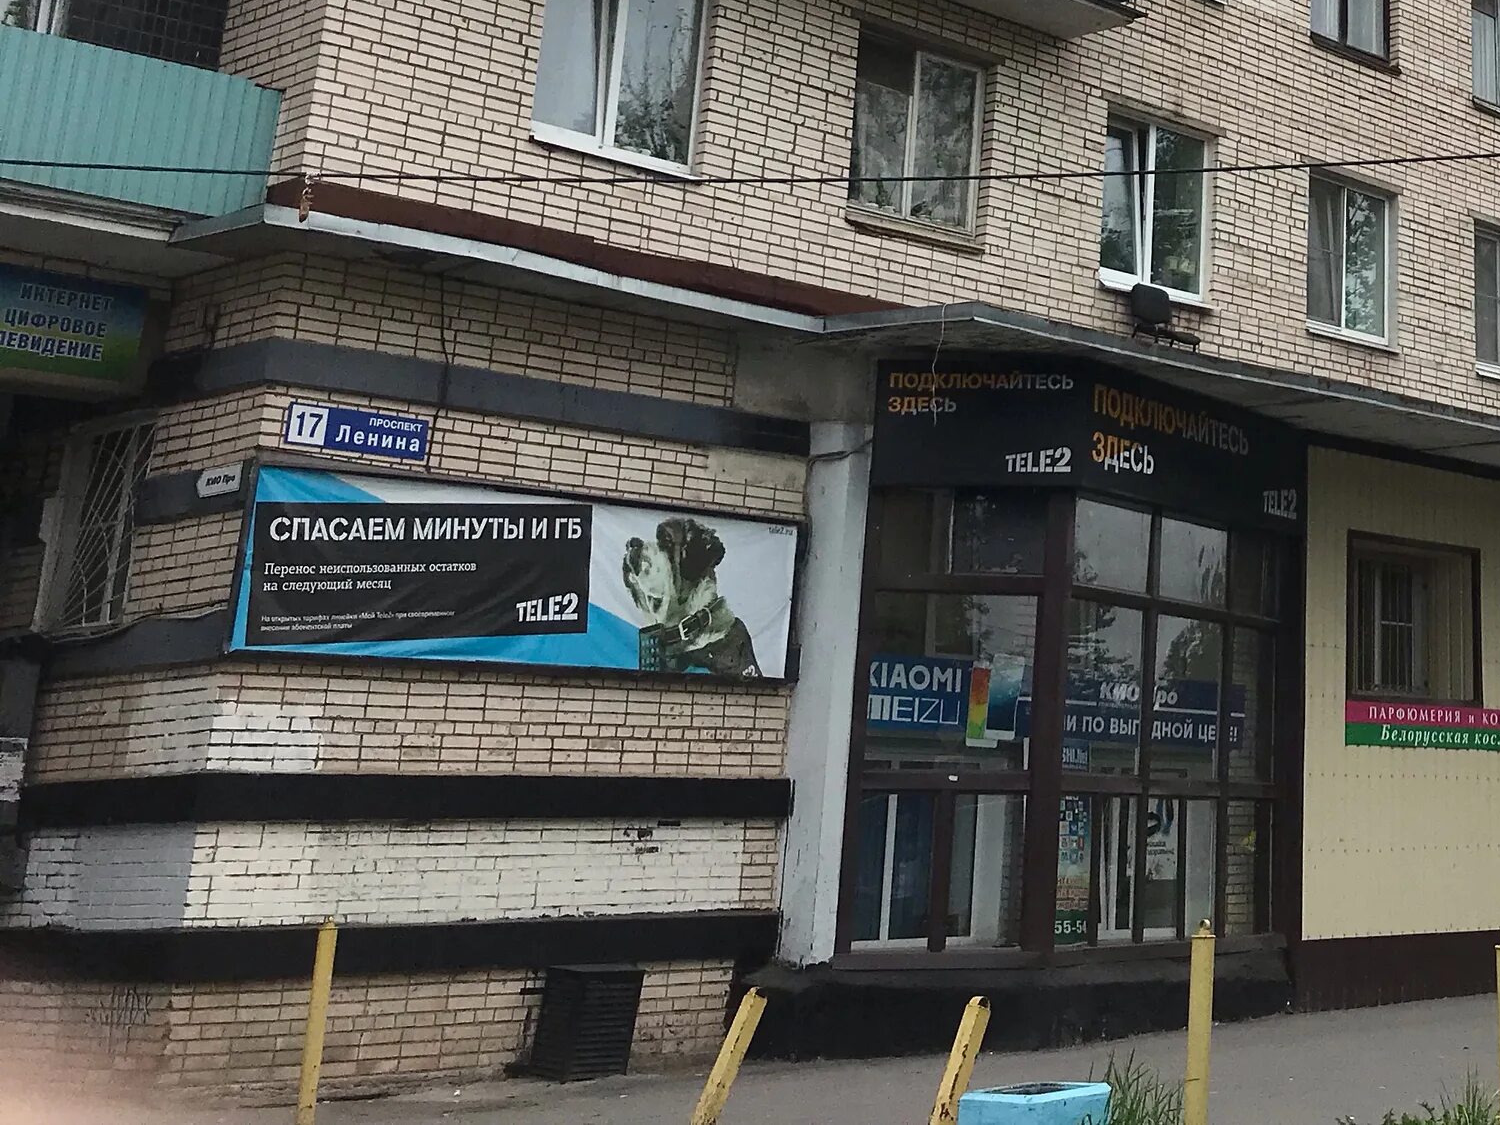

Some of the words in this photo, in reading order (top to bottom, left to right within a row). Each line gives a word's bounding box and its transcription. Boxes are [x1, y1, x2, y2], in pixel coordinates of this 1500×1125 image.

[20, 283, 114, 311] ИНТЕРНЕТ
[4, 308, 108, 339] ЦИФРОВОЕ
[889, 371, 1074, 392] ПОДКЛЮЧАЙТЕСЬ
[888, 396, 957, 415] ЗДЕСЬ
[296, 412, 324, 438] 17
[369, 417, 423, 433] ПРОСПЕКТ
[1093, 383, 1249, 456] ПОДКЛЮЧАЙТЕСЬ
[335, 425, 420, 452] Ленина
[1005, 446, 1072, 473] TELE2
[1091, 431, 1155, 475] ЗДЕСЬ
[1263, 489, 1297, 520] TELE2
[269, 517, 405, 542] СПАСАЕМ
[413, 518, 524, 541] МИНУТЫ
[531, 518, 548, 540] И
[555, 517, 583, 540] ГБ
[264, 563, 316, 578] Перенос
[319, 562, 426, 575] неиспользованных
[428, 561, 477, 573] остатков
[263, 581, 279, 592] на
[282, 578, 353, 595] следующий
[356, 579, 392, 591] месяц
[516, 592, 579, 623] TELE2
[869, 661, 962, 693] XIAOMI
[1368, 705, 1461, 723] ПАРФЮМЕРИЯ
[1468, 714, 1475, 723] и
[1082, 715, 1105, 733] ПО
[1109, 717, 1193, 740] ВЫГДНОЙ
[1381, 723, 1469, 746] Белорусская
